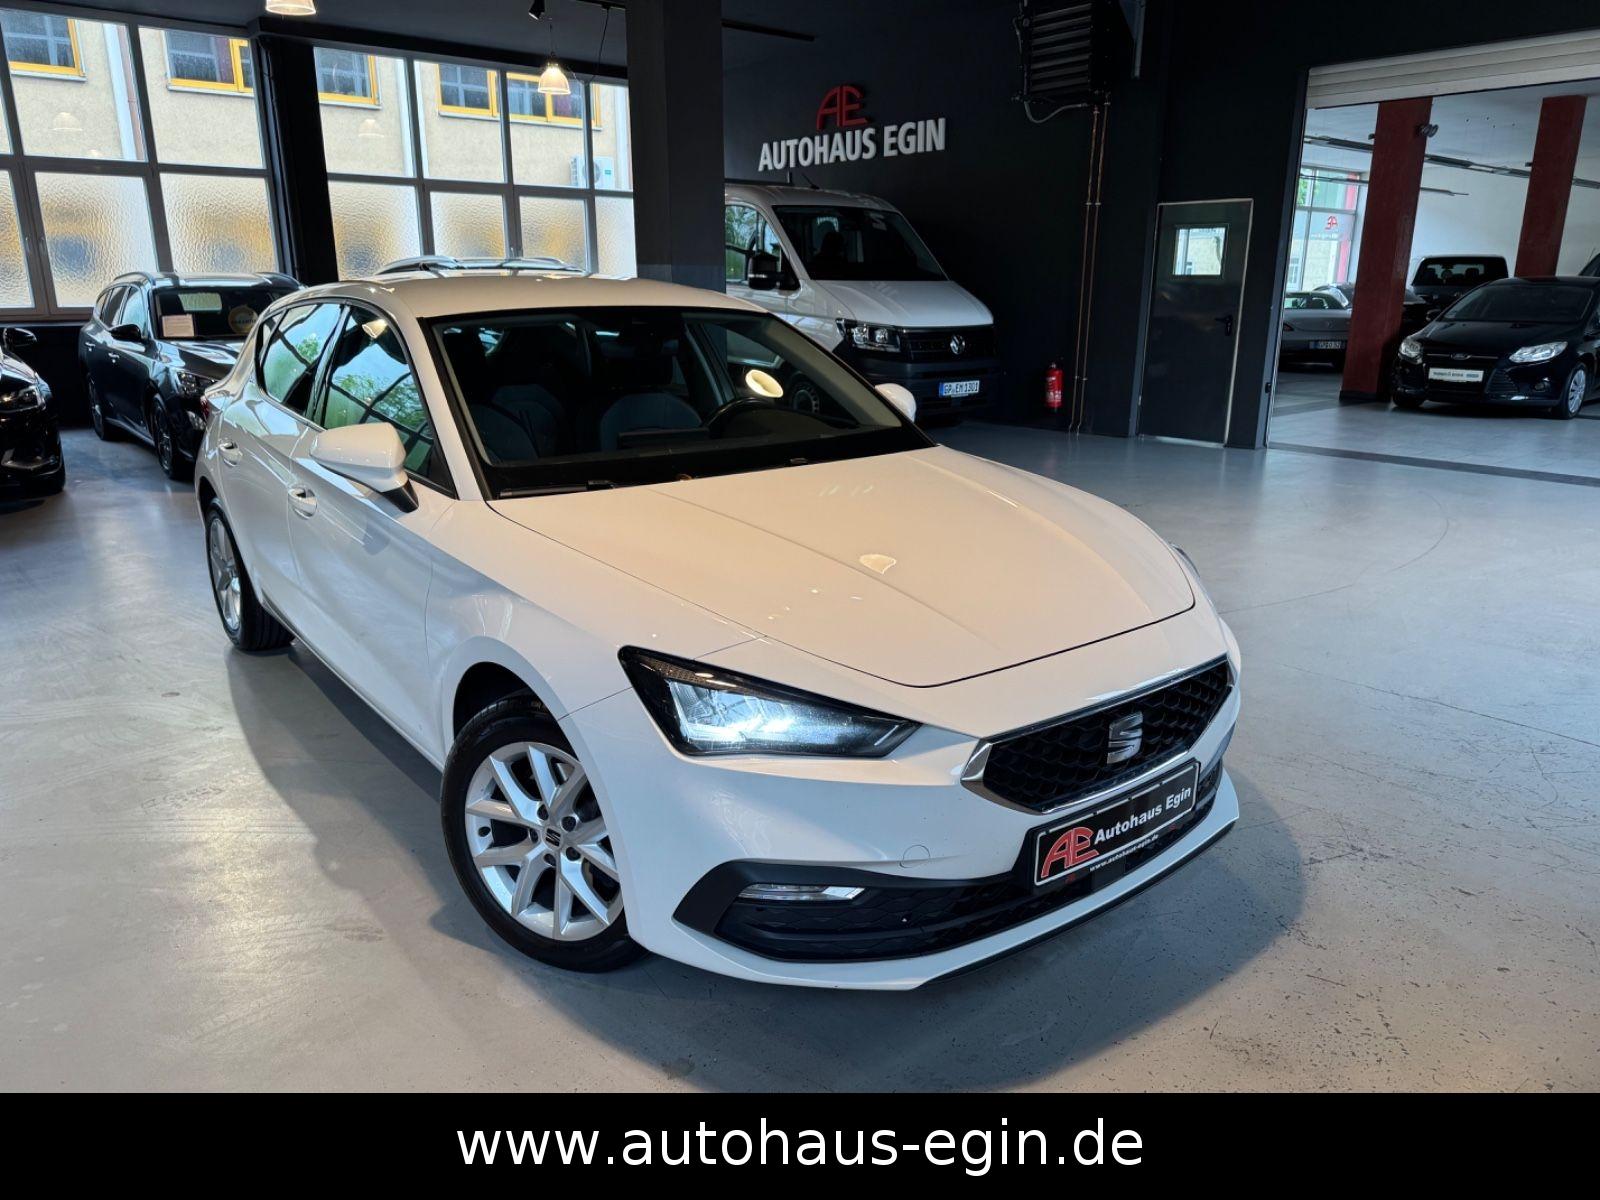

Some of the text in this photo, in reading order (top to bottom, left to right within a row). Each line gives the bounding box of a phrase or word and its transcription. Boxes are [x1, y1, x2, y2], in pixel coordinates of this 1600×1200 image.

[758, 118, 946, 171] AUTOHAUS EGIN
[1094, 803, 1162, 845] Autohaus
[1165, 786, 1191, 812] Egin
